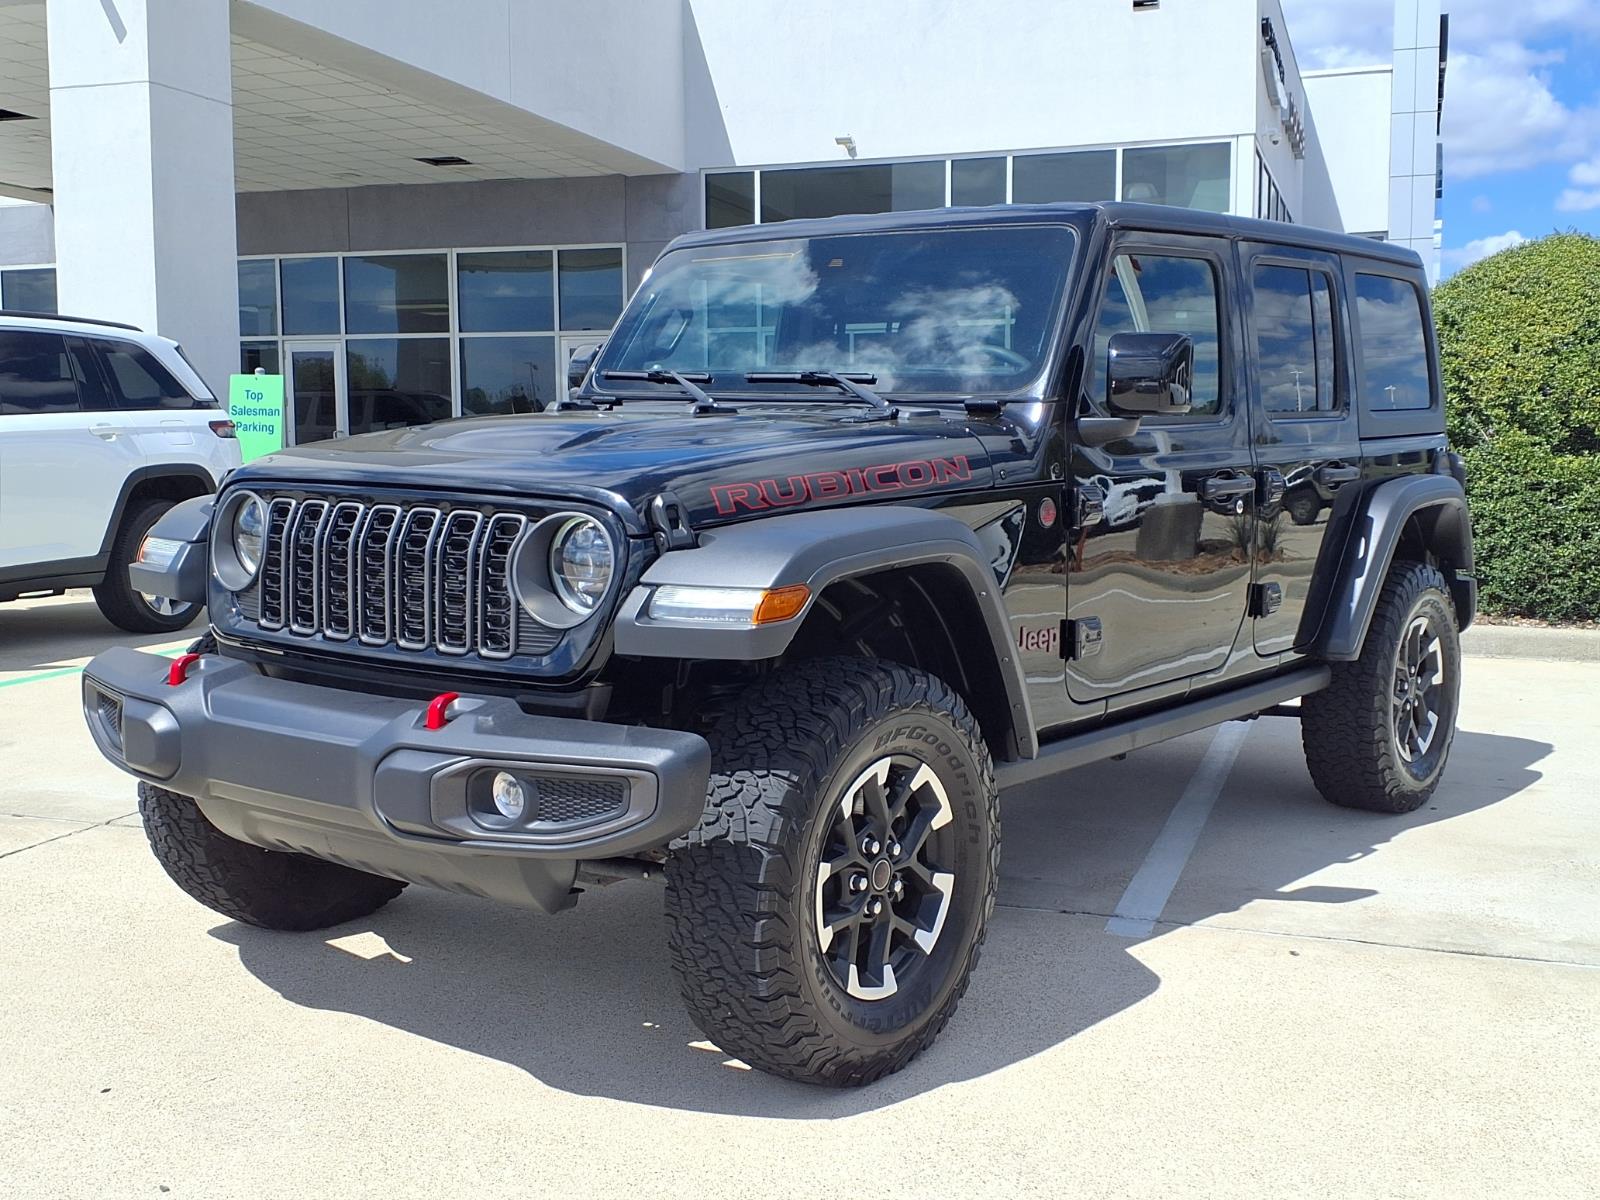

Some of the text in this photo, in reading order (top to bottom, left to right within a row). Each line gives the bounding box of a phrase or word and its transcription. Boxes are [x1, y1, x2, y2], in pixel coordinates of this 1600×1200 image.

[245, 389, 263, 402] Top
[231, 405, 280, 416] Salesman
[236, 421, 275, 435] Parking
[710, 455, 973, 515] RUBICON
[1017, 625, 1057, 653] Jeep
[873, 726, 982, 845] BFGoodrich
